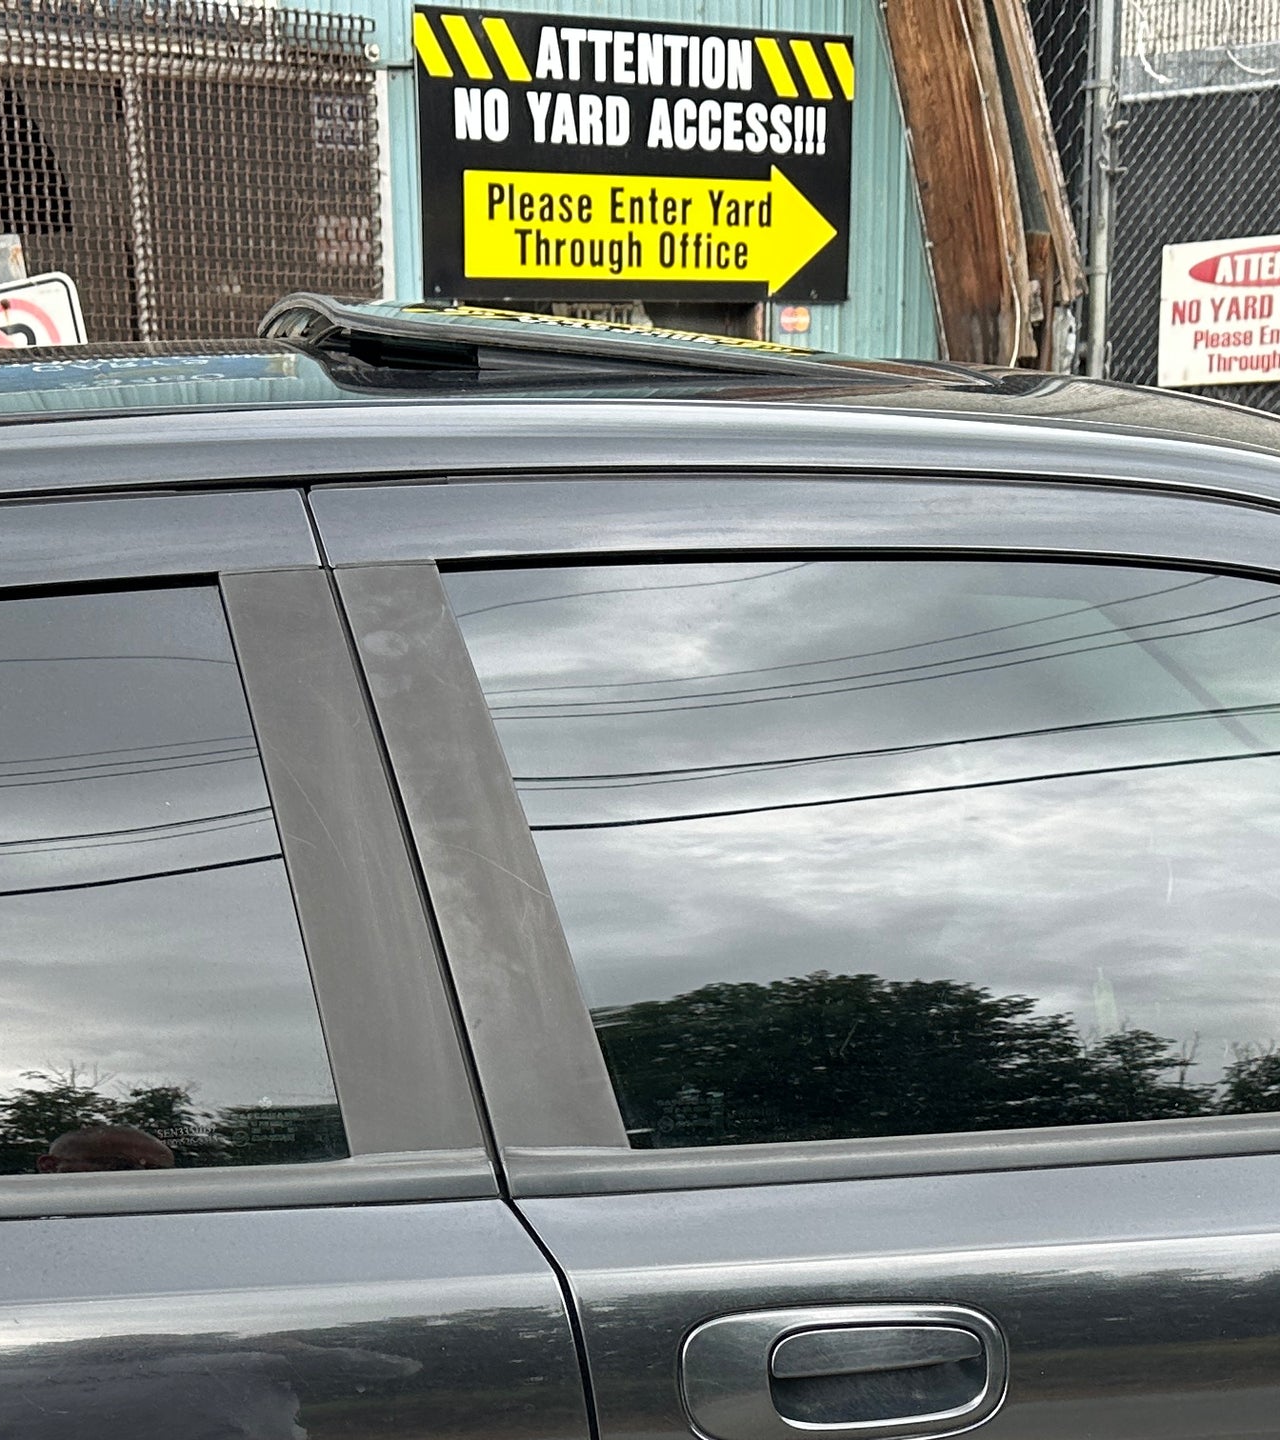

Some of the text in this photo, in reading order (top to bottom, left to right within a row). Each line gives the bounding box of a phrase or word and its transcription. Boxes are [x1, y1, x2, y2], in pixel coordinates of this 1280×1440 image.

[535, 26, 752, 90] ATTENTION
[454, 87, 826, 155] NO YARD ACCESS!!!
[487, 183, 772, 228] Please Enter Yard
[515, 229, 748, 273] Through Office
[1171, 299, 1201, 325] NO
[1211, 294, 1273, 323] YARD
[1193, 329, 1252, 350] Please
